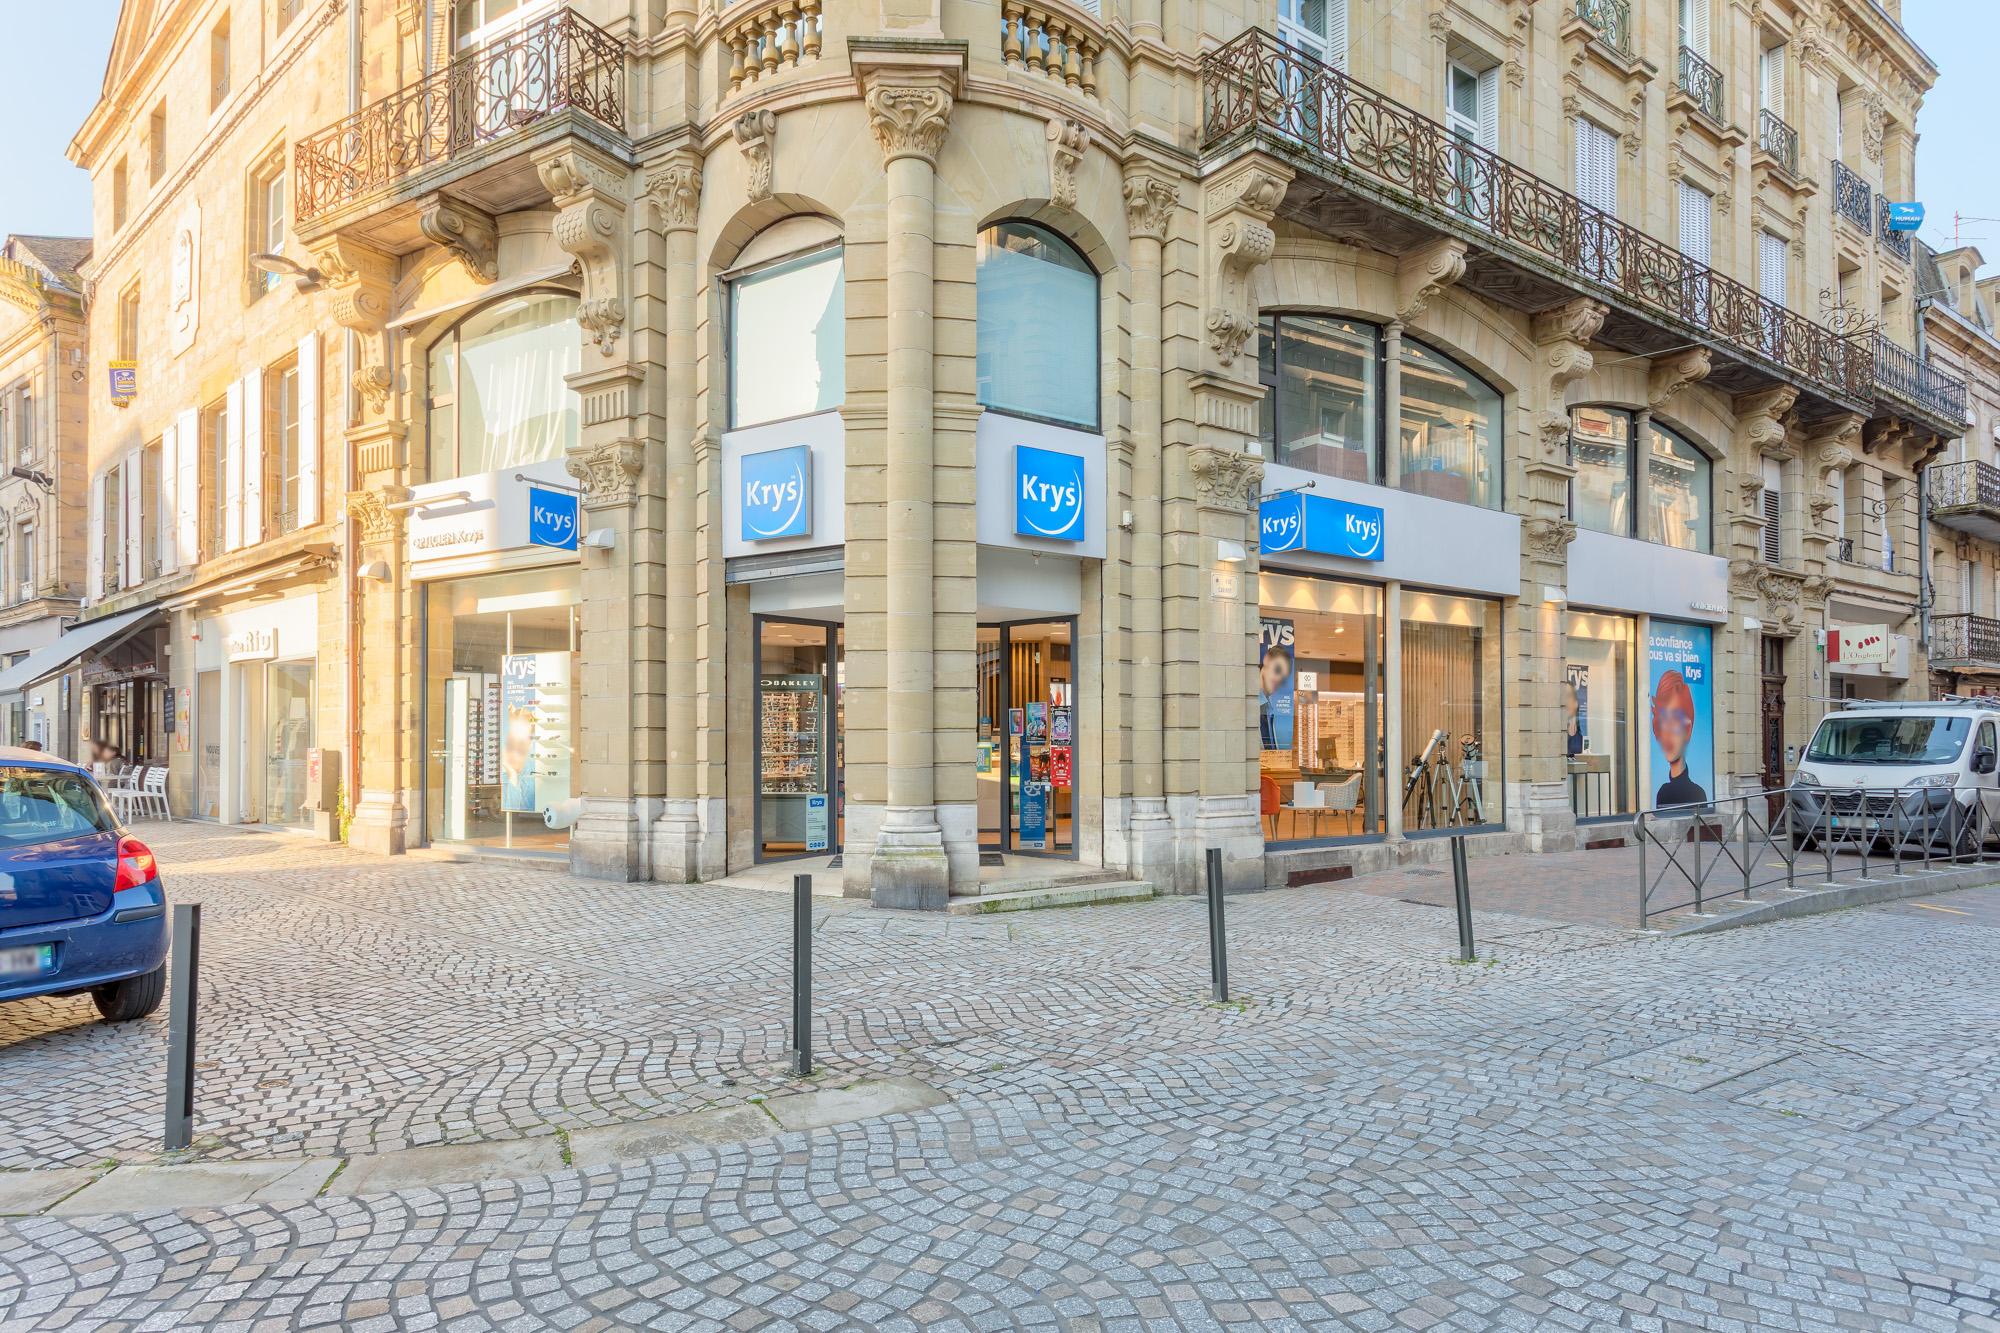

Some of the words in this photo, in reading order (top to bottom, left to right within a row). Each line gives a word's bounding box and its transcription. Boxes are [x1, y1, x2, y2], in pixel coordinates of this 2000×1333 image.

[746, 480, 797, 512] Krys
[1022, 474, 1076, 512] Krys
[533, 505, 572, 531] Krys
[1262, 514, 1297, 536] Krys
[1345, 513, 1377, 540] Krys
[1655, 636, 1693, 649] confiance
[1664, 652, 1673, 661] va
[1674, 650, 1681, 662] si
[1682, 651, 1699, 663] bien
[1685, 666, 1702, 680] Krys
